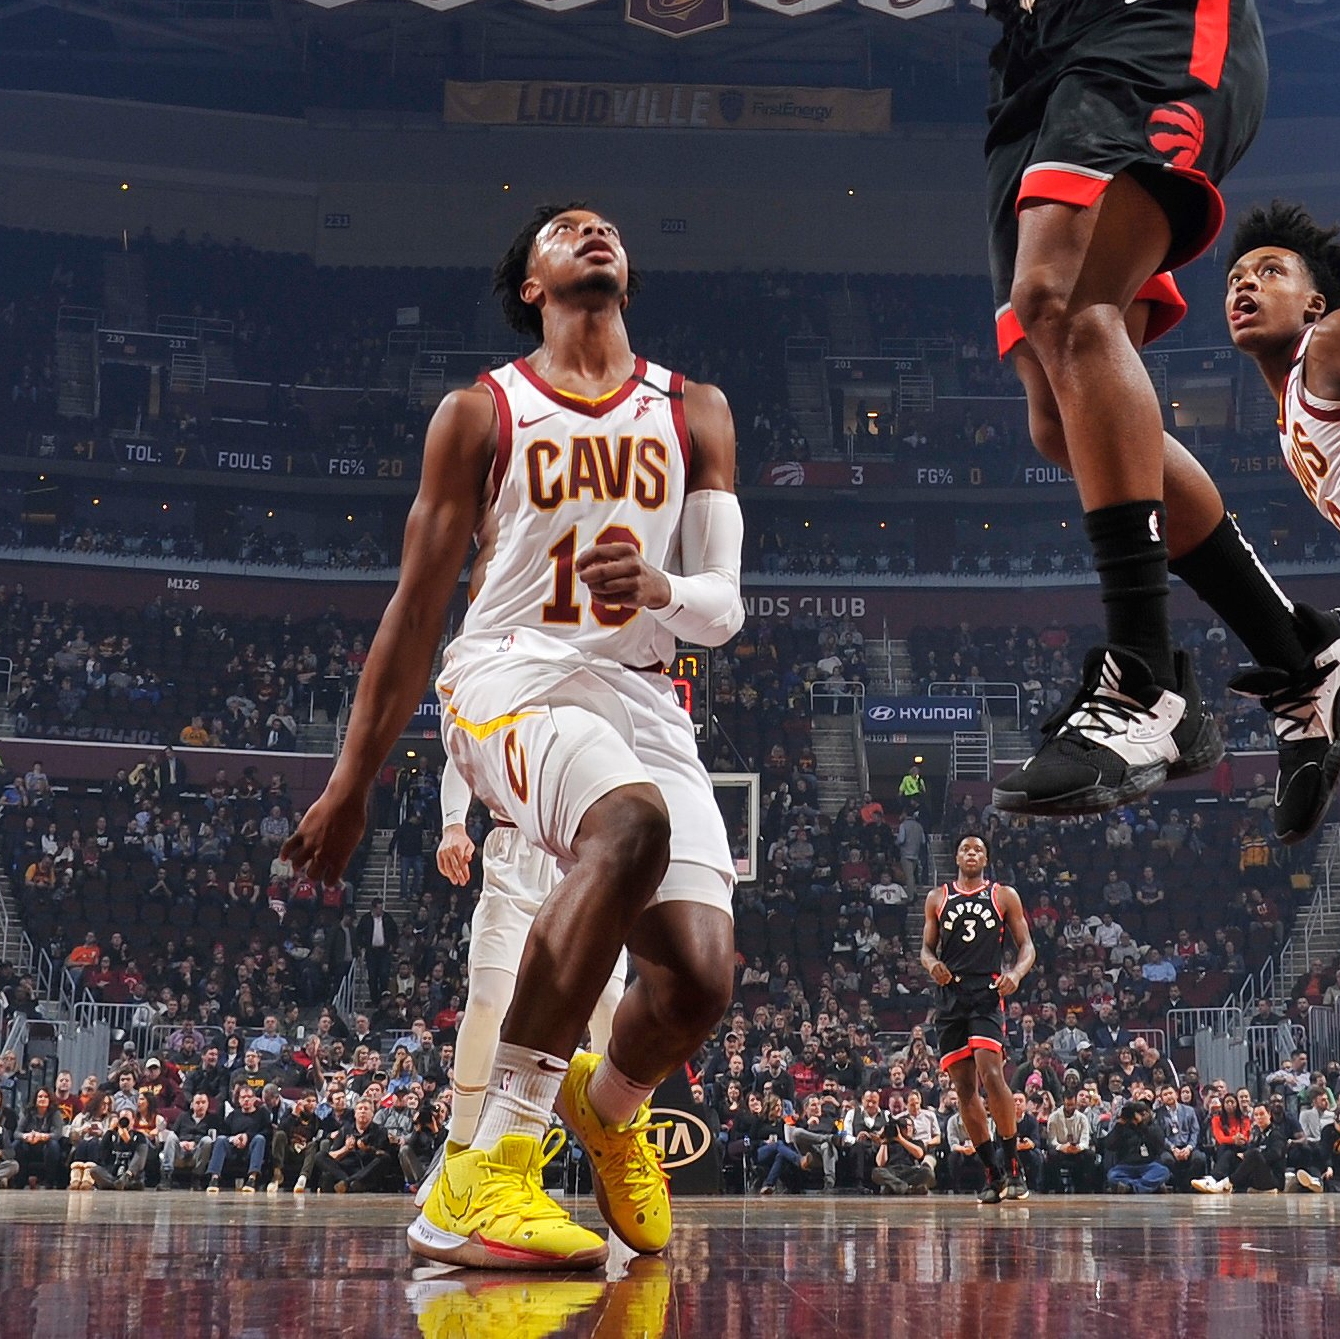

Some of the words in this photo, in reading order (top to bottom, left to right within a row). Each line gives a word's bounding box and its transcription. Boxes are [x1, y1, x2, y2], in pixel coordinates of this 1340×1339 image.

[517, 85, 710, 126] LOUDVILLE
[218, 451, 272, 471] FOULS
[329, 459, 365, 476] FG%
[377, 459, 403, 477] 20
[525, 435, 668, 512] CAVS
[851, 466, 864, 486] 3
[917, 468, 954, 485] FG%
[167, 578, 200, 592] M126
[900, 707, 973, 720] HYUNDAI
[943, 901, 996, 931] RAPTORS
[962, 919, 977, 942] 3
